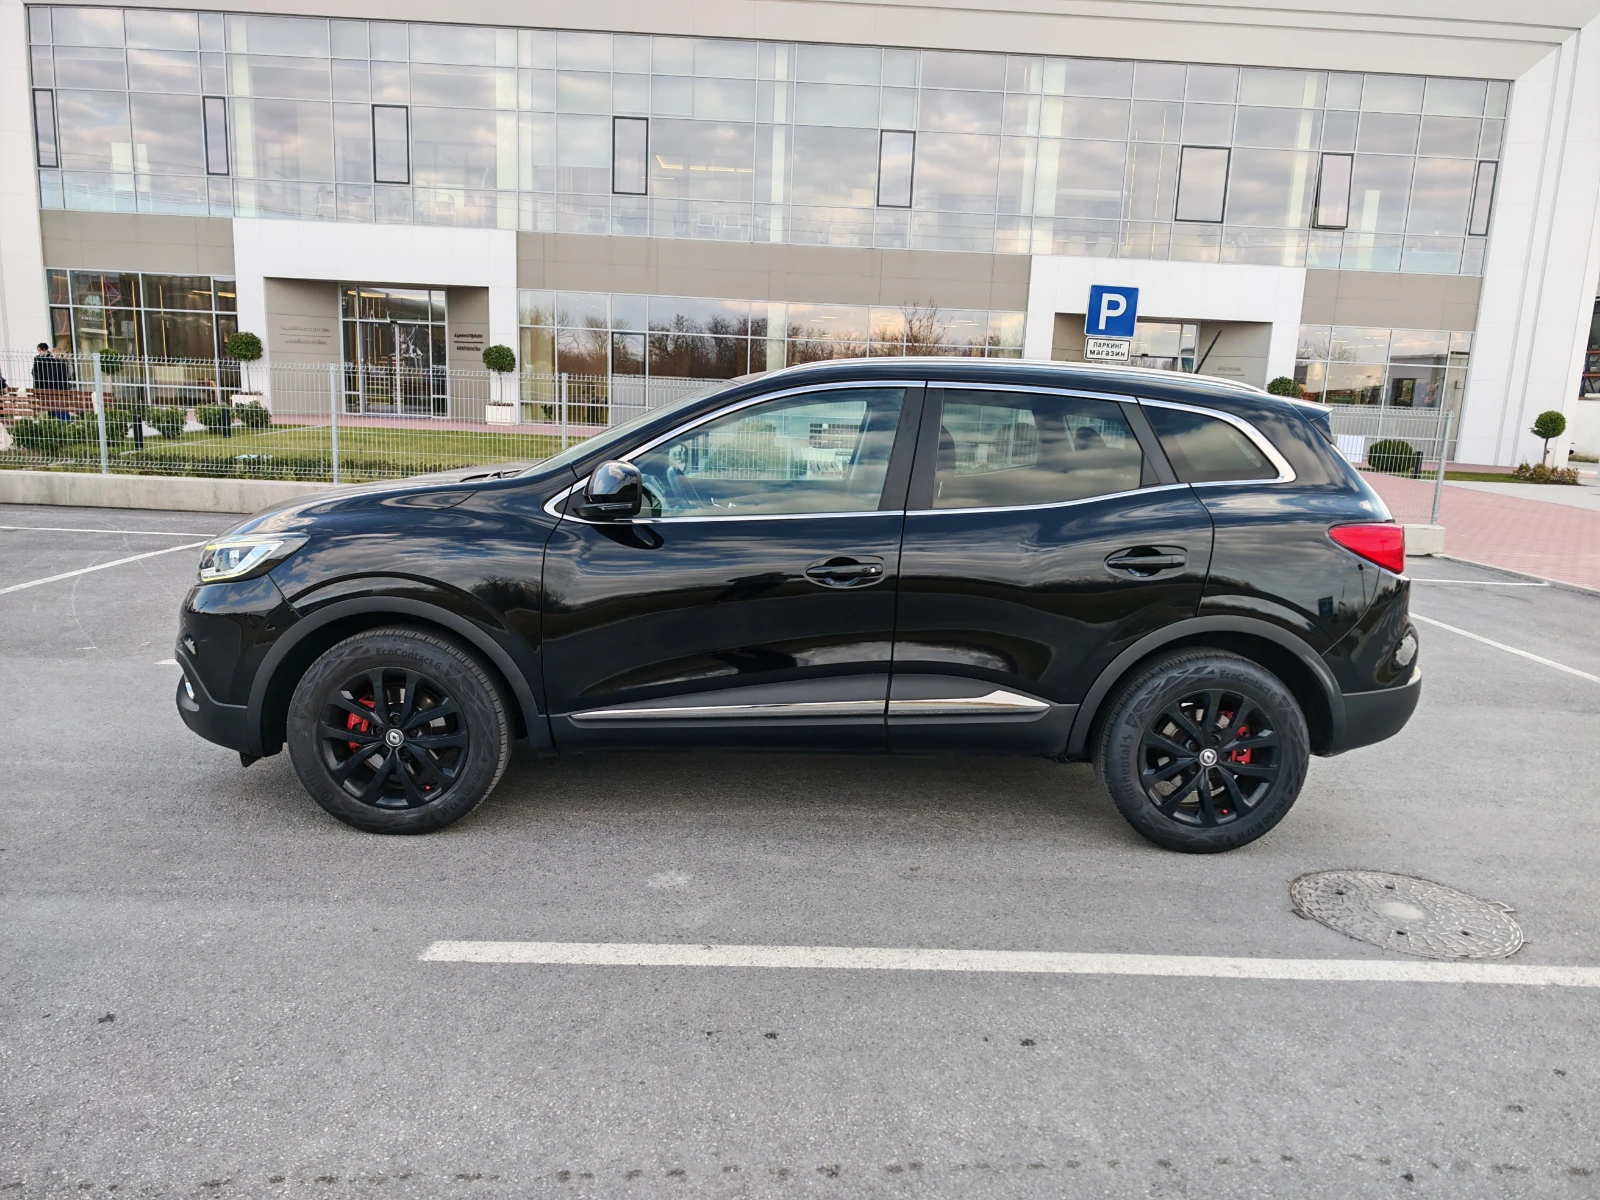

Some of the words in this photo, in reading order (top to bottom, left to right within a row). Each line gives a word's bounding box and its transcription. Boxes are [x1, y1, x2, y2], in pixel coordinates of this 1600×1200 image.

[1098, 293, 1127, 330] P
[1089, 349, 1126, 358] магазин
[1092, 341, 1124, 350] ПАРКИНГ
[375, 647, 434, 667] EcoContact
[434, 661, 443, 670] 6
[1219, 670, 1271, 696] EcoContact
[1270, 691, 1278, 700] 6
